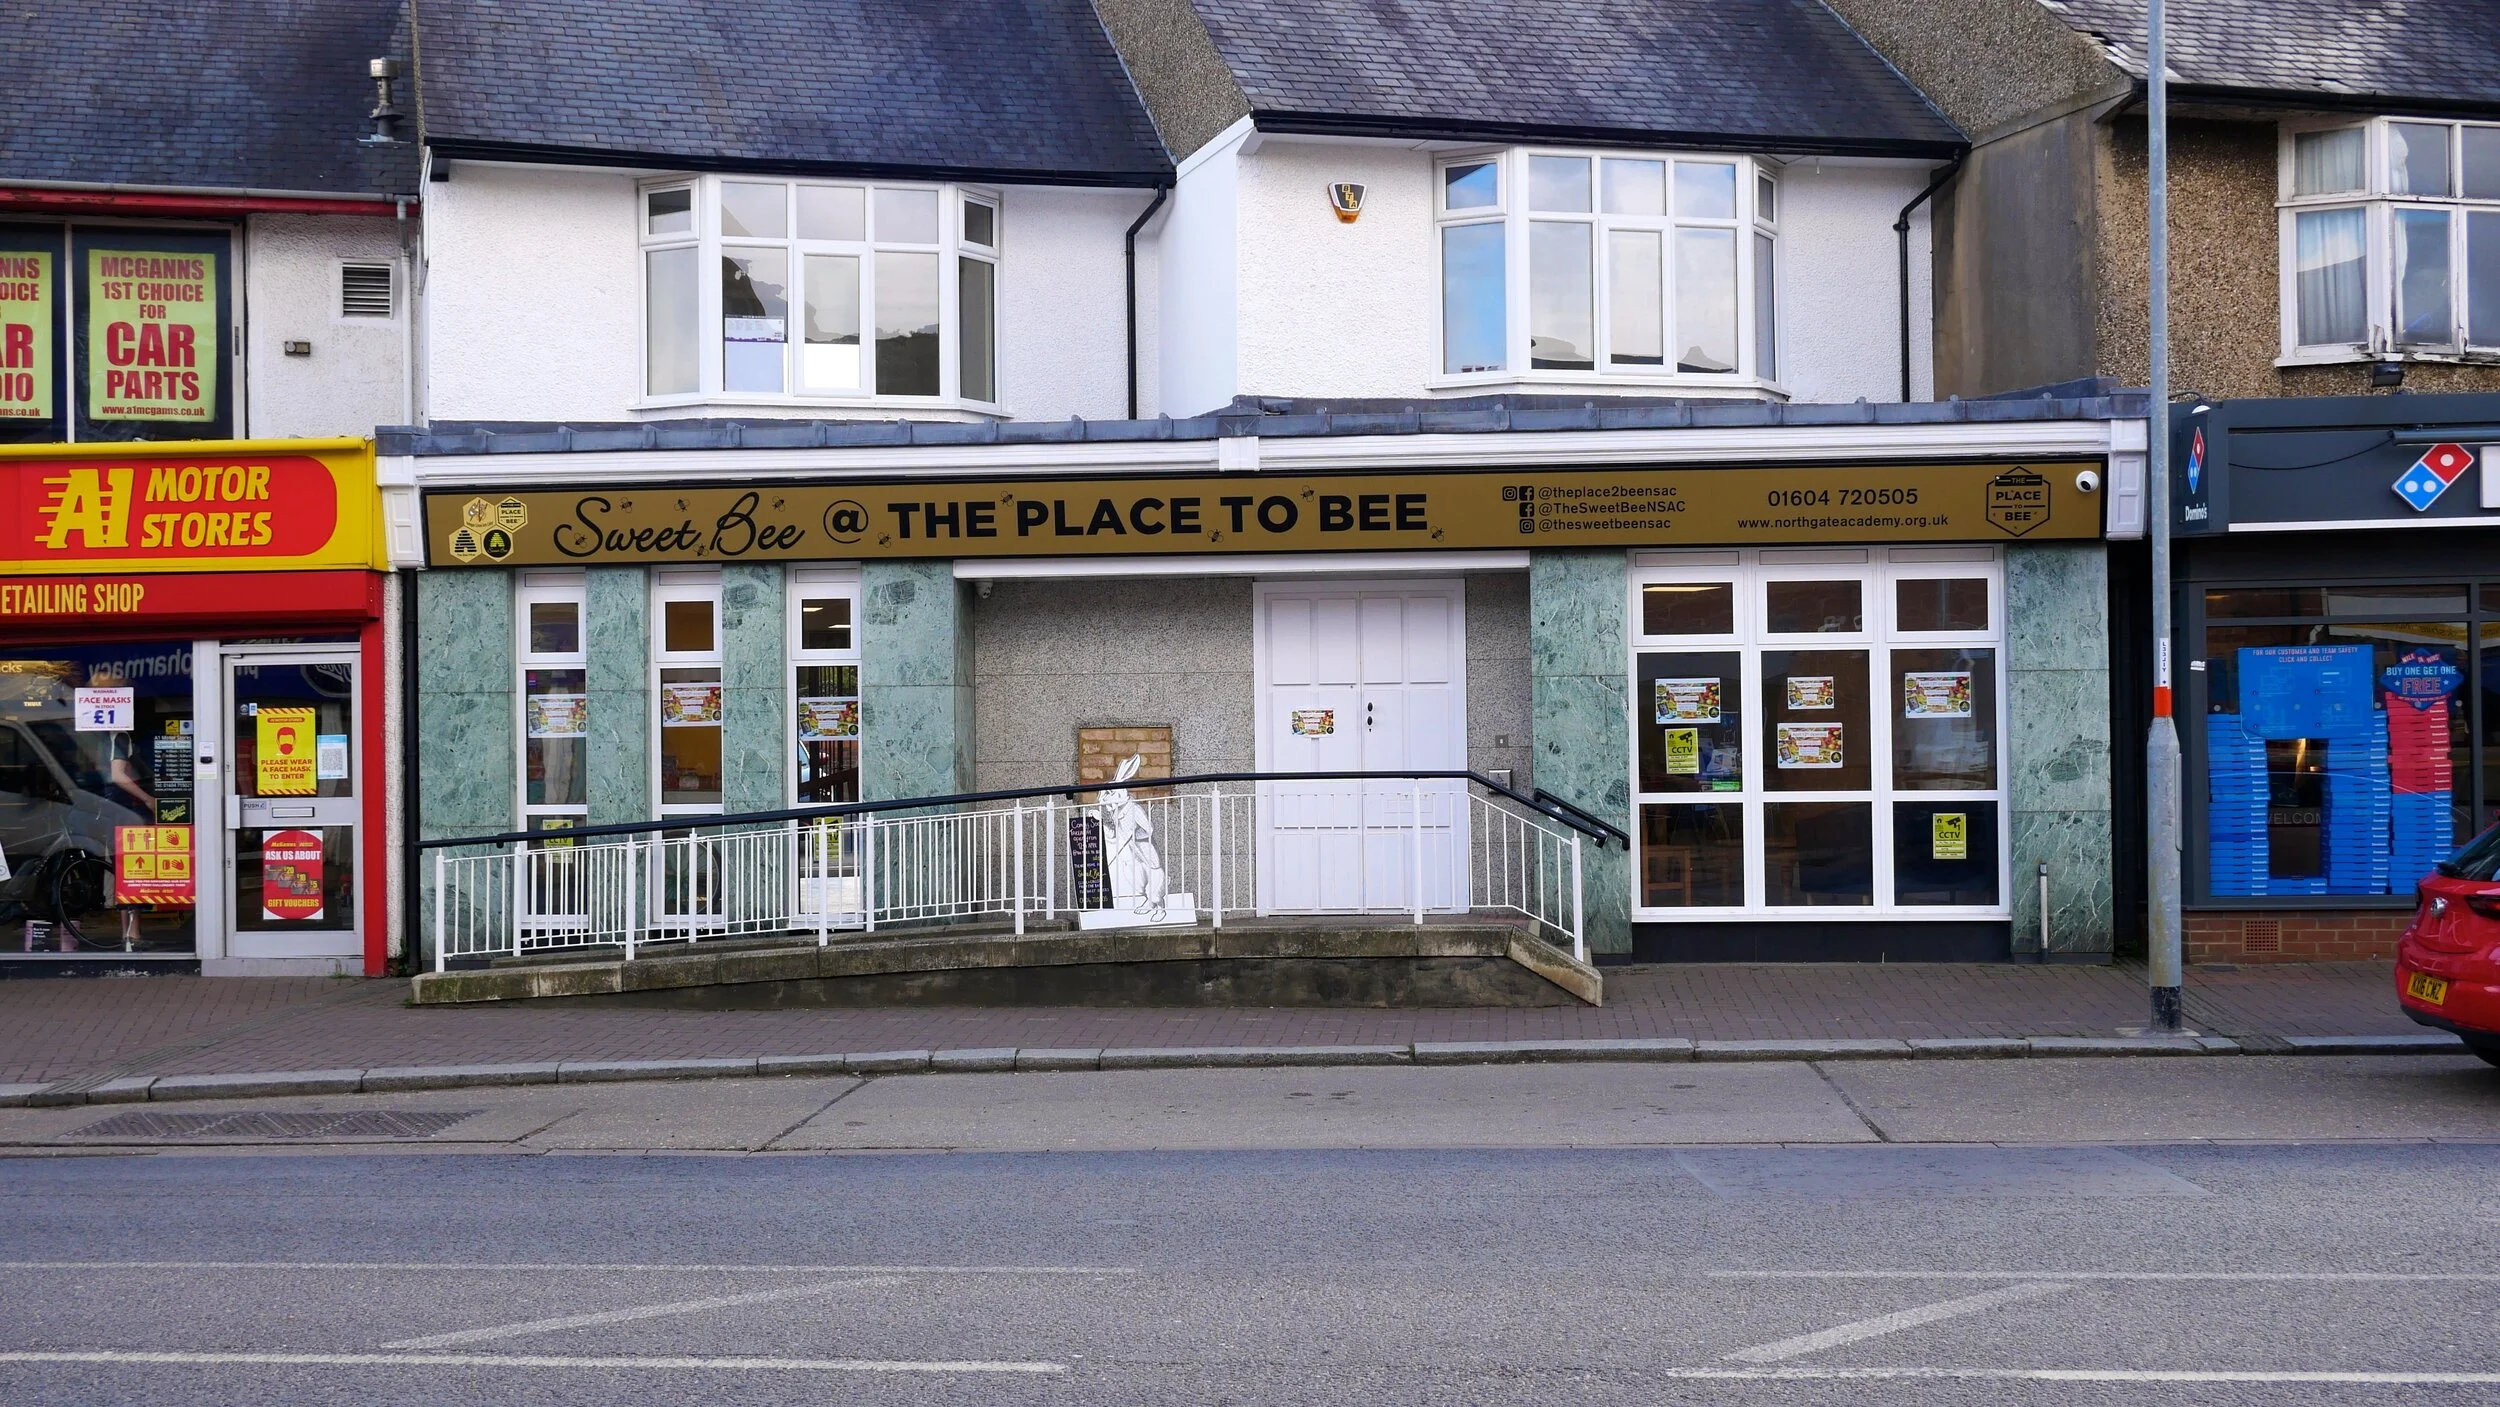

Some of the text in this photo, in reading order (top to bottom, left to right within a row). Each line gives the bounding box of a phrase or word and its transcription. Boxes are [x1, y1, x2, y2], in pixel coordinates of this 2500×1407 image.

[101, 256, 204, 280] MCGANNS
[102, 281, 203, 302] 1ST CHOICE
[139, 304, 166, 319] FOR
[0, 323, 34, 368] R
[106, 321, 195, 367] CAR
[107, 370, 200, 401] PARTS
[102, 406, 205, 416] www.a1mcganns.co.uk
[145, 466, 270, 502] MOTOR
[1539, 486, 1677, 500] @theplace2beensac
[1767, 488, 1918, 506] 01604 720505
[1996, 490, 2041, 500] PLACE
[1539, 501, 1685, 516] @TheSweetBeeNSAC
[2185, 502, 2208, 522] Domino's
[1737, 514, 1949, 529] www.northgateacademy.org.uk
[2005, 512, 2031, 521] BEE
[141, 511, 272, 547] STORES
[553, 492, 1427, 557] Sweet Bee @ THE PLACE TO BEE
[1539, 518, 1671, 532] @thesweetbeensac
[1, 583, 145, 614] ETAILING SHOP
[2386, 666, 2457, 676] BUY ONE GET ONE
[2402, 677, 2442, 694] FREE
[79, 696, 131, 704] FACE MASKS
[2268, 812, 2321, 824] ELCO
[265, 850, 321, 860] ASK US ABOUT
[268, 898, 319, 907] GIFT VOUCHERS
